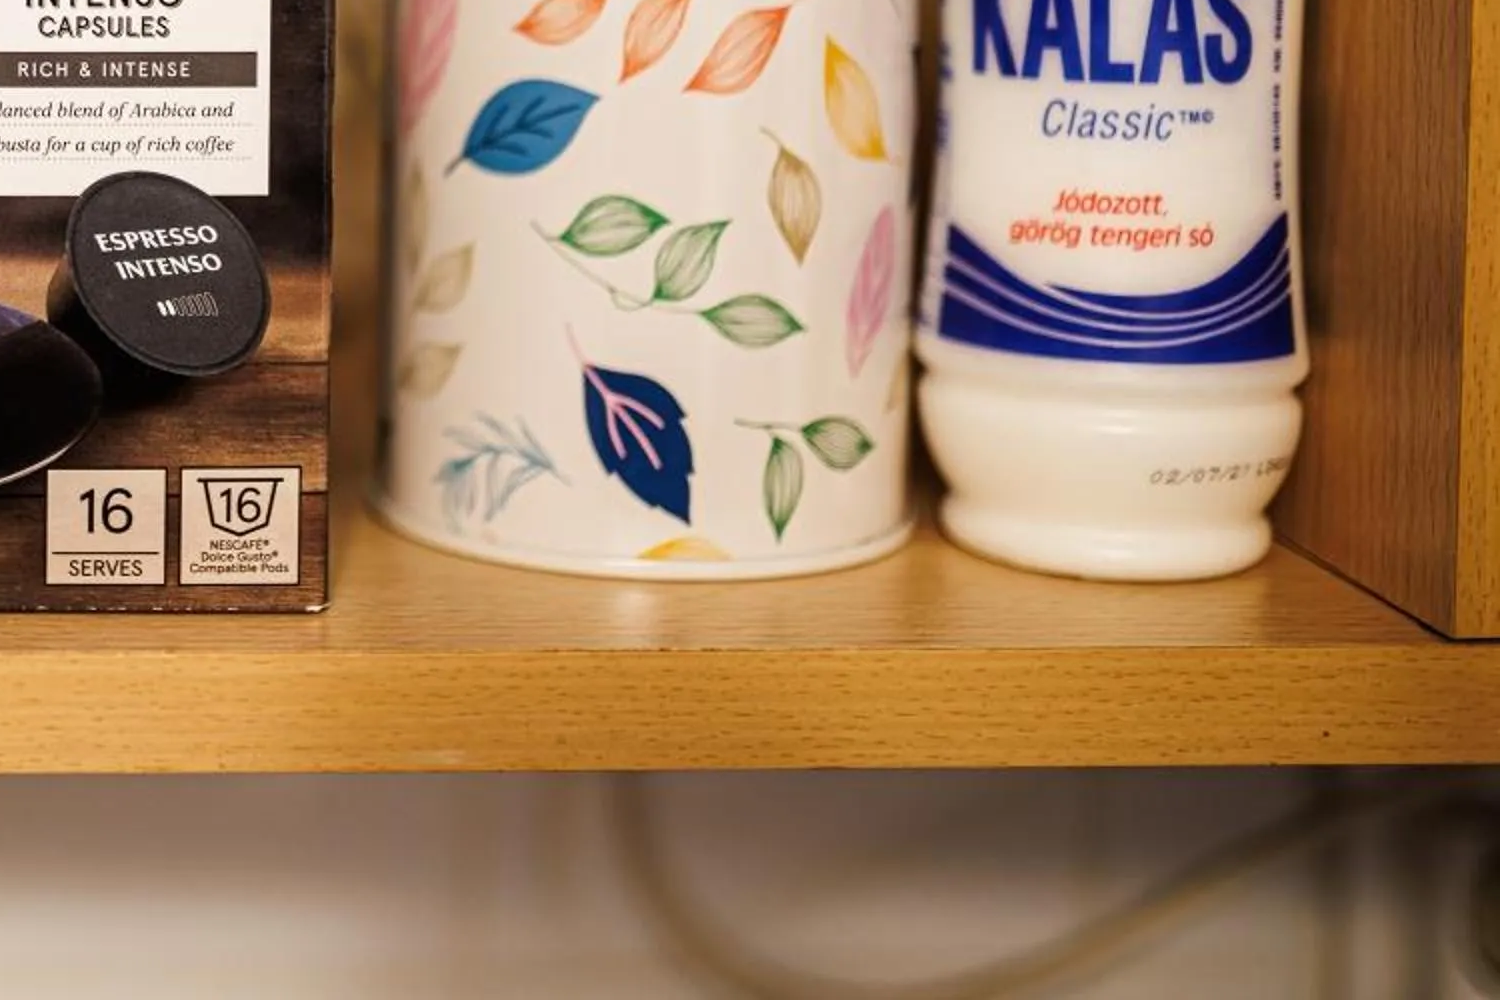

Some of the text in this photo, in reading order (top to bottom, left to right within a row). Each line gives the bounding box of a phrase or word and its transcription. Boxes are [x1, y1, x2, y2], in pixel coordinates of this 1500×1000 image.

[38, 15, 171, 39] CAPSULES
[17, 61, 192, 78] RICH & INTENSE
[57, 101, 104, 119] blend
[107, 101, 128, 122] of
[129, 101, 196, 119] Arabica
[201, 101, 235, 119] and
[42, 135, 71, 156] for
[74, 140, 86, 153] a
[90, 140, 121, 156] cup
[125, 135, 143, 156] of
[147, 135, 181, 153] rich
[184, 135, 235, 157] coffee
[94, 225, 219, 253] ESPRESSO
[1008, 220, 1215, 251] görög tengeri só
[113, 253, 222, 280] INTENSO
[79, 488, 133, 534] 16
[219, 487, 262, 523] 16
[68, 559, 143, 577] SERVES
[201, 551, 235, 562] Dolce
[189, 563, 290, 574] Compatible Pods
